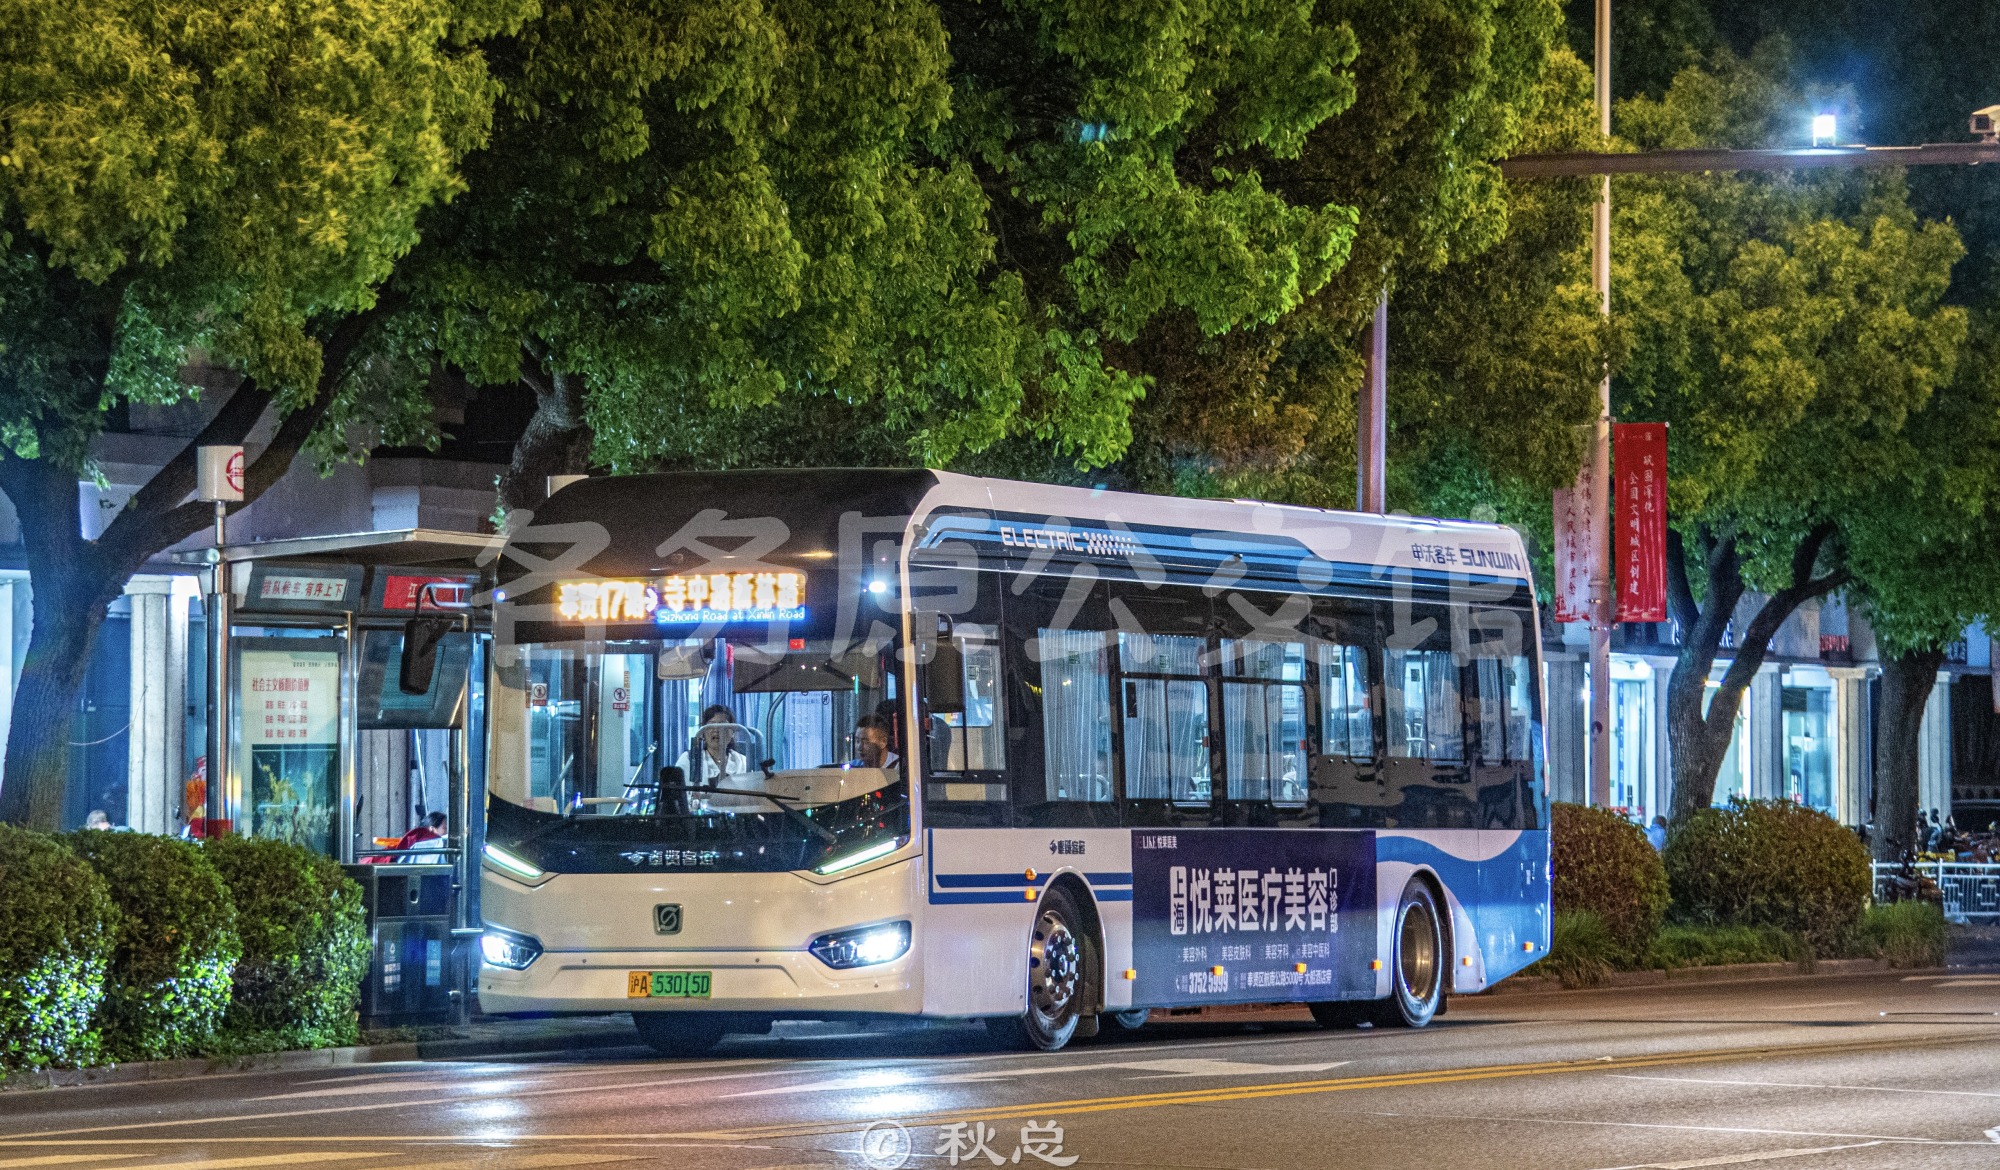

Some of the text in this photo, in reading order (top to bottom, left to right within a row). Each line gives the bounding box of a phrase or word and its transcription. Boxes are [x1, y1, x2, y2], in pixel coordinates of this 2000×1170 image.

[1001, 527, 1084, 551] ELECTRIC
[1411, 543, 1521, 571] 申沃客车 SUNWIN
[305, 581, 345, 598] 有序上下
[703, 610, 728, 621] Road
[732, 610, 744, 620] at
[779, 608, 806, 620] Road
[1172, 868, 1187, 933] 上海
[1189, 867, 1329, 934] 悦莱医疗美容
[1329, 867, 1339, 934] 门诊部
